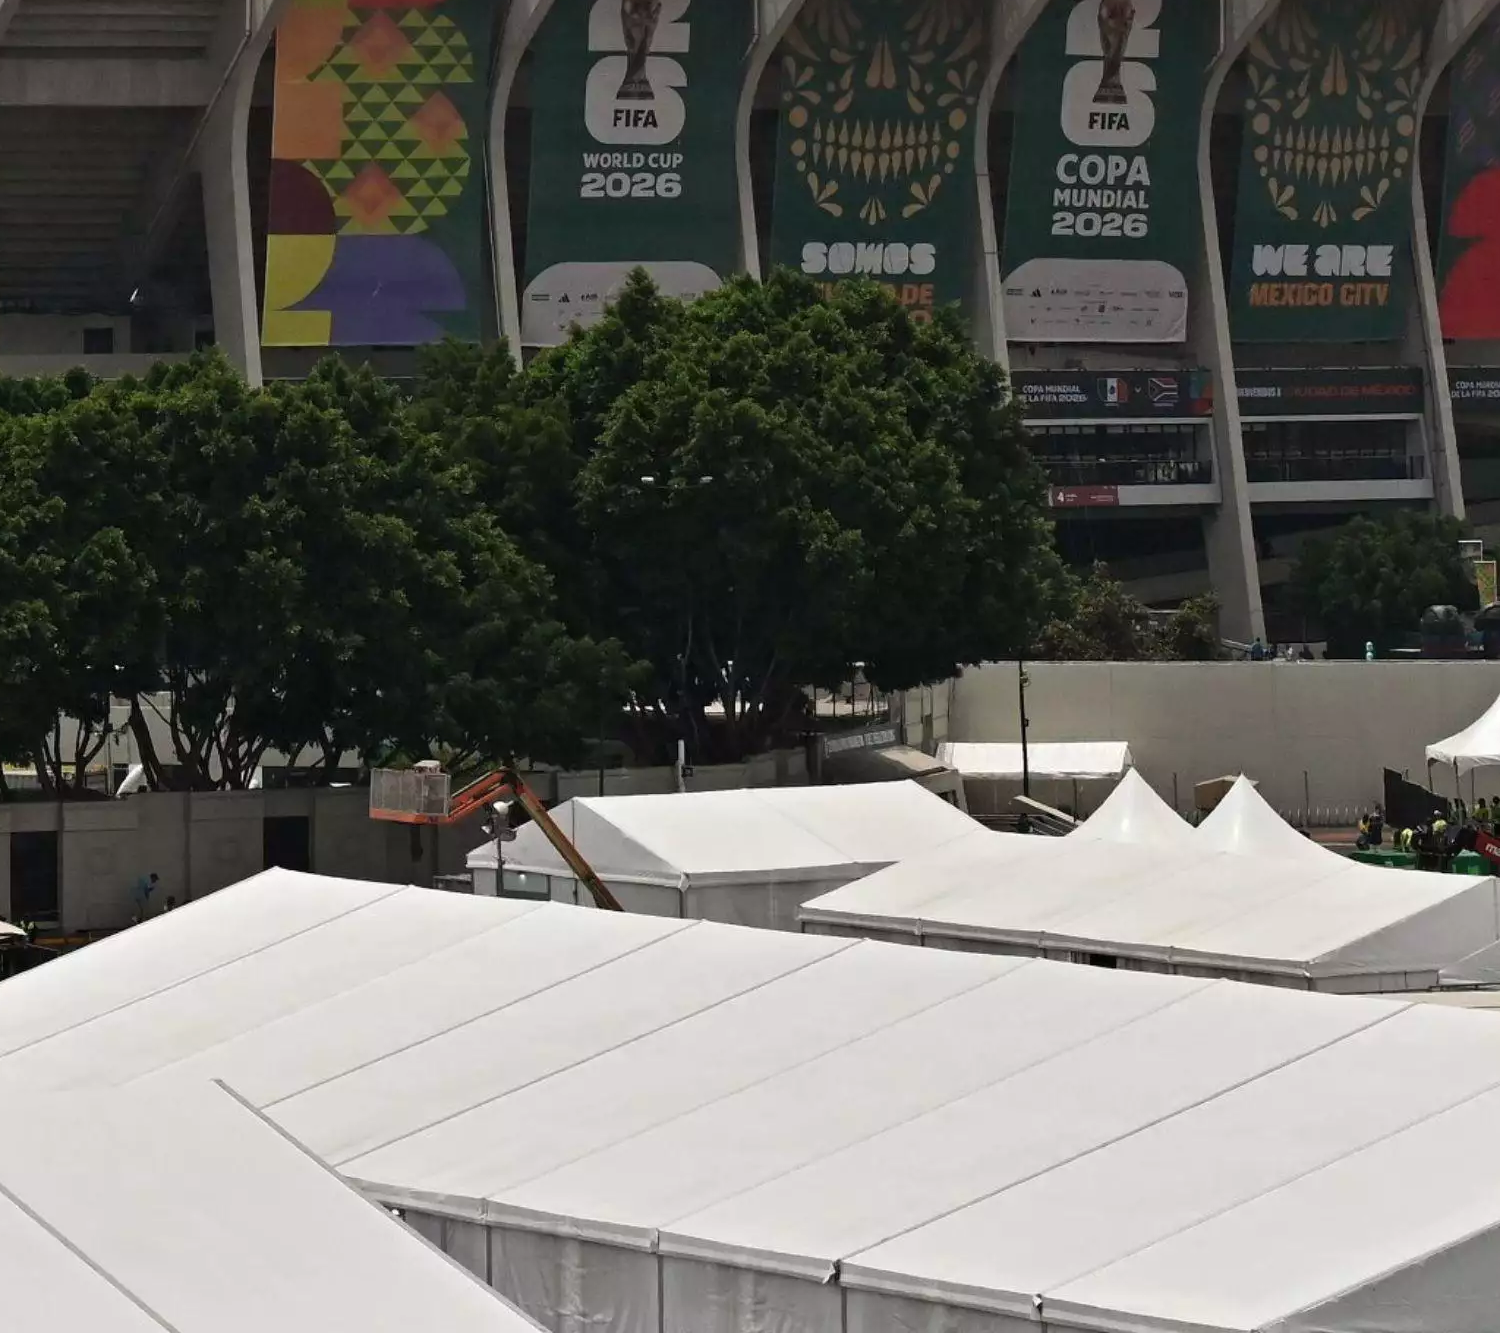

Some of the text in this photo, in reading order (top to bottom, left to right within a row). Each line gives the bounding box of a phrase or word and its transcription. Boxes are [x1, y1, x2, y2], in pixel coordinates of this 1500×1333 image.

[612, 109, 659, 129] FIFA
[1088, 112, 1130, 131] FIFA
[583, 153, 684, 169] WORLD CUP
[1056, 154, 1151, 186] COPA
[581, 173, 682, 198] 2026
[1053, 188, 1150, 209] MUNDIAL
[1052, 212, 1148, 238] 2026
[801, 242, 936, 275] SOMOS
[1252, 244, 1309, 277] WE
